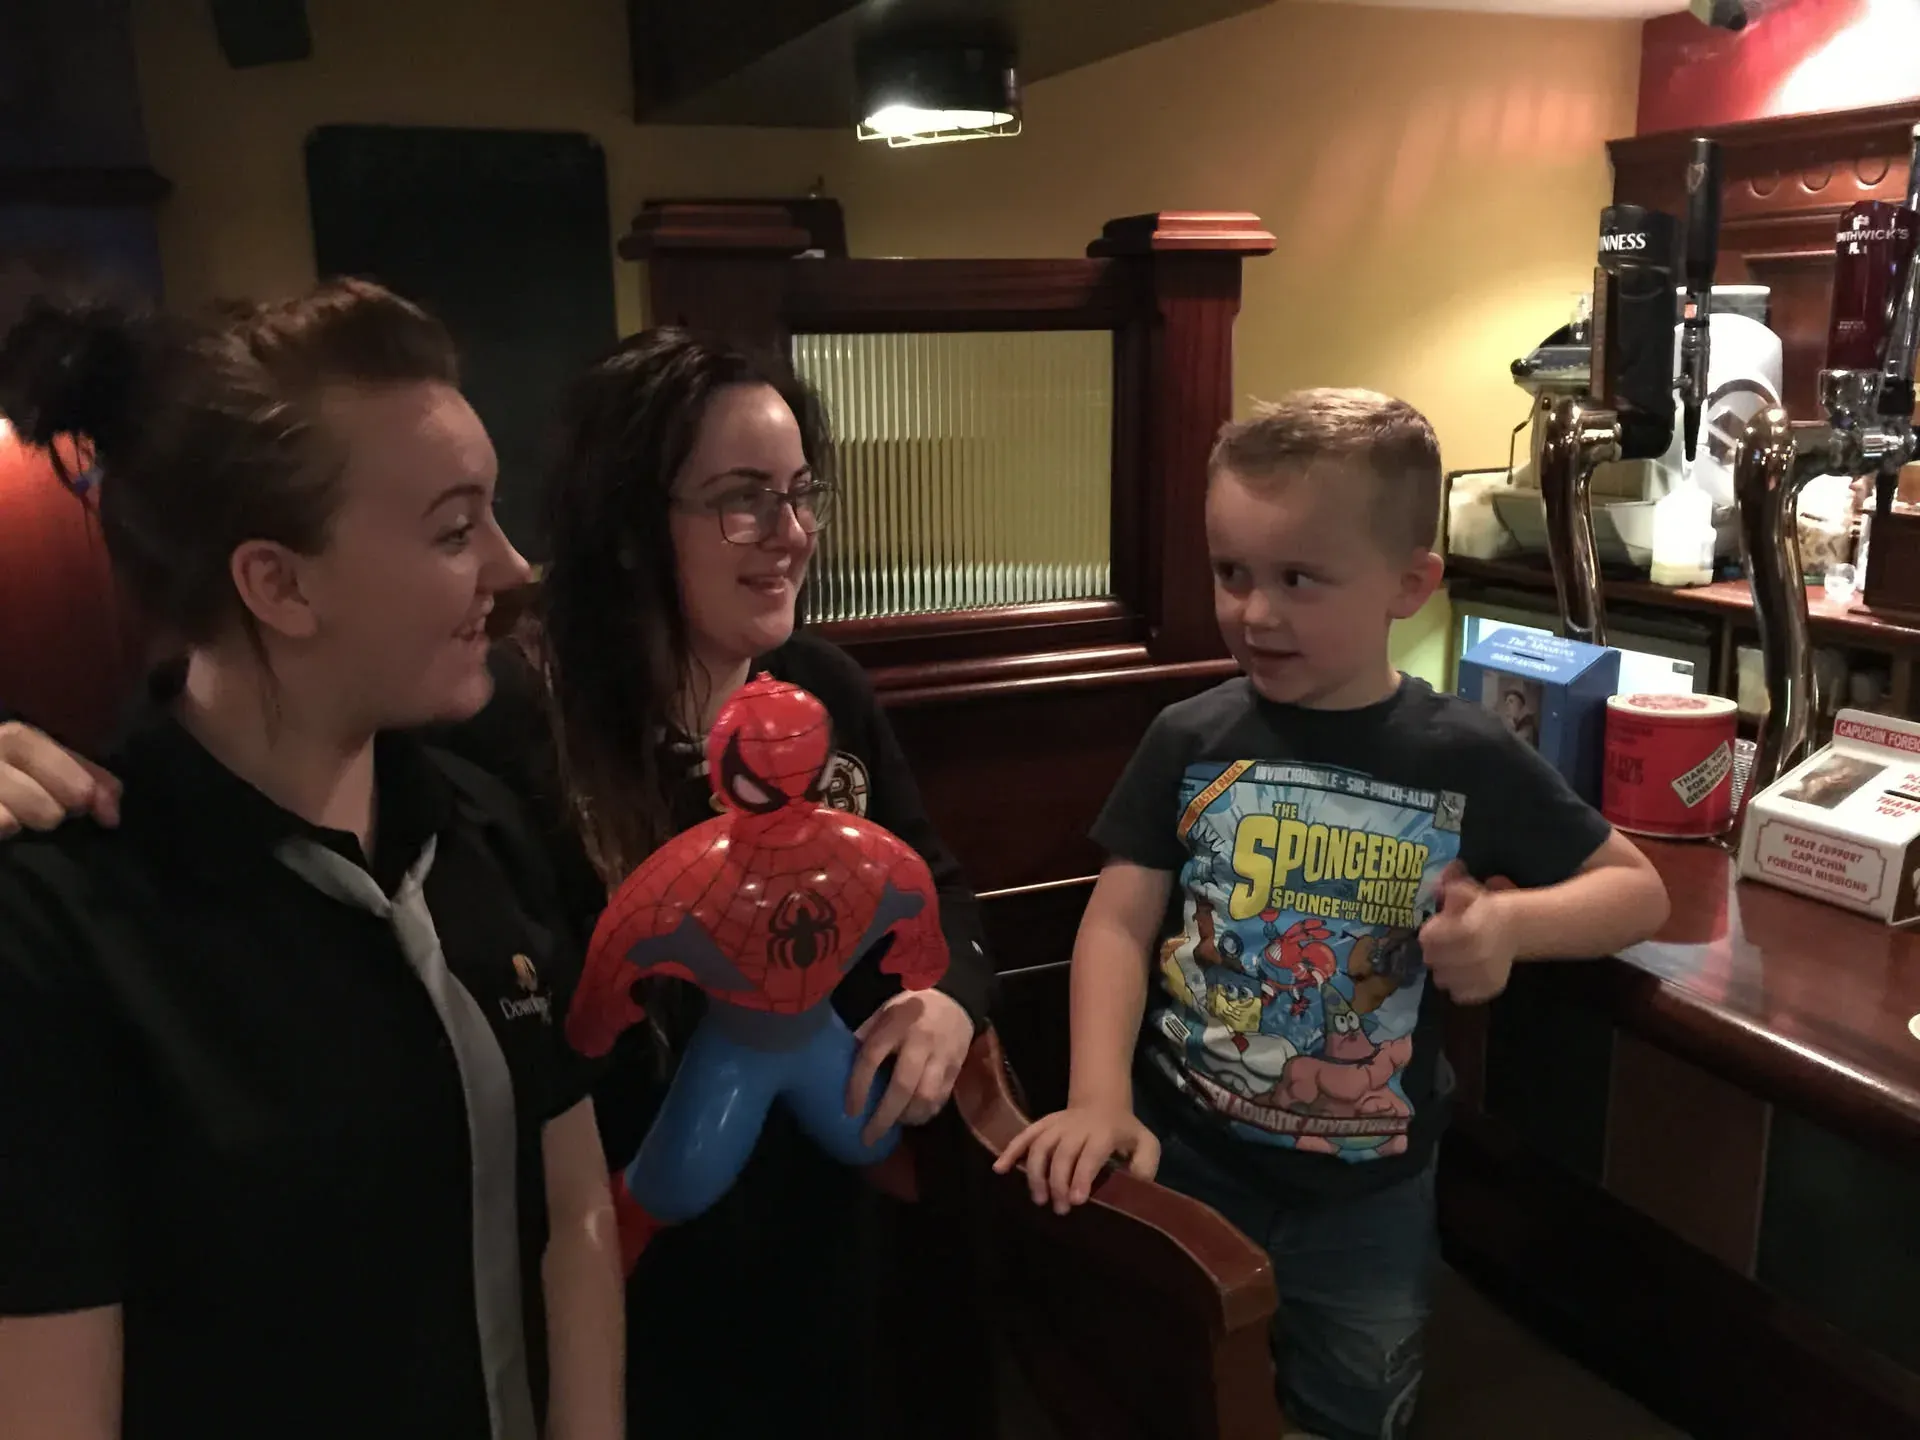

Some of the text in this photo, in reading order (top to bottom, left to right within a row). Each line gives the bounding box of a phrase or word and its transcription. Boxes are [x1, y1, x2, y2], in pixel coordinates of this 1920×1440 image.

[1838, 722, 1886, 745] CAPUCHIN
[1677, 761, 1708, 787] THANK
[1686, 776, 1706, 792] FOR
[1274, 803, 1298, 819] THE
[1875, 806, 1906, 818] YOU
[1783, 832, 1864, 864] PLEASE SUPPORT
[1229, 814, 1429, 920] SPONGEBOB
[1767, 855, 1868, 894] FOREIGN MISSIONS
[1791, 849, 1847, 874] CAPUCHIN
[1357, 880, 1420, 908] MOVIE
[1271, 888, 1415, 928] SPONGE OUT OF WATER
